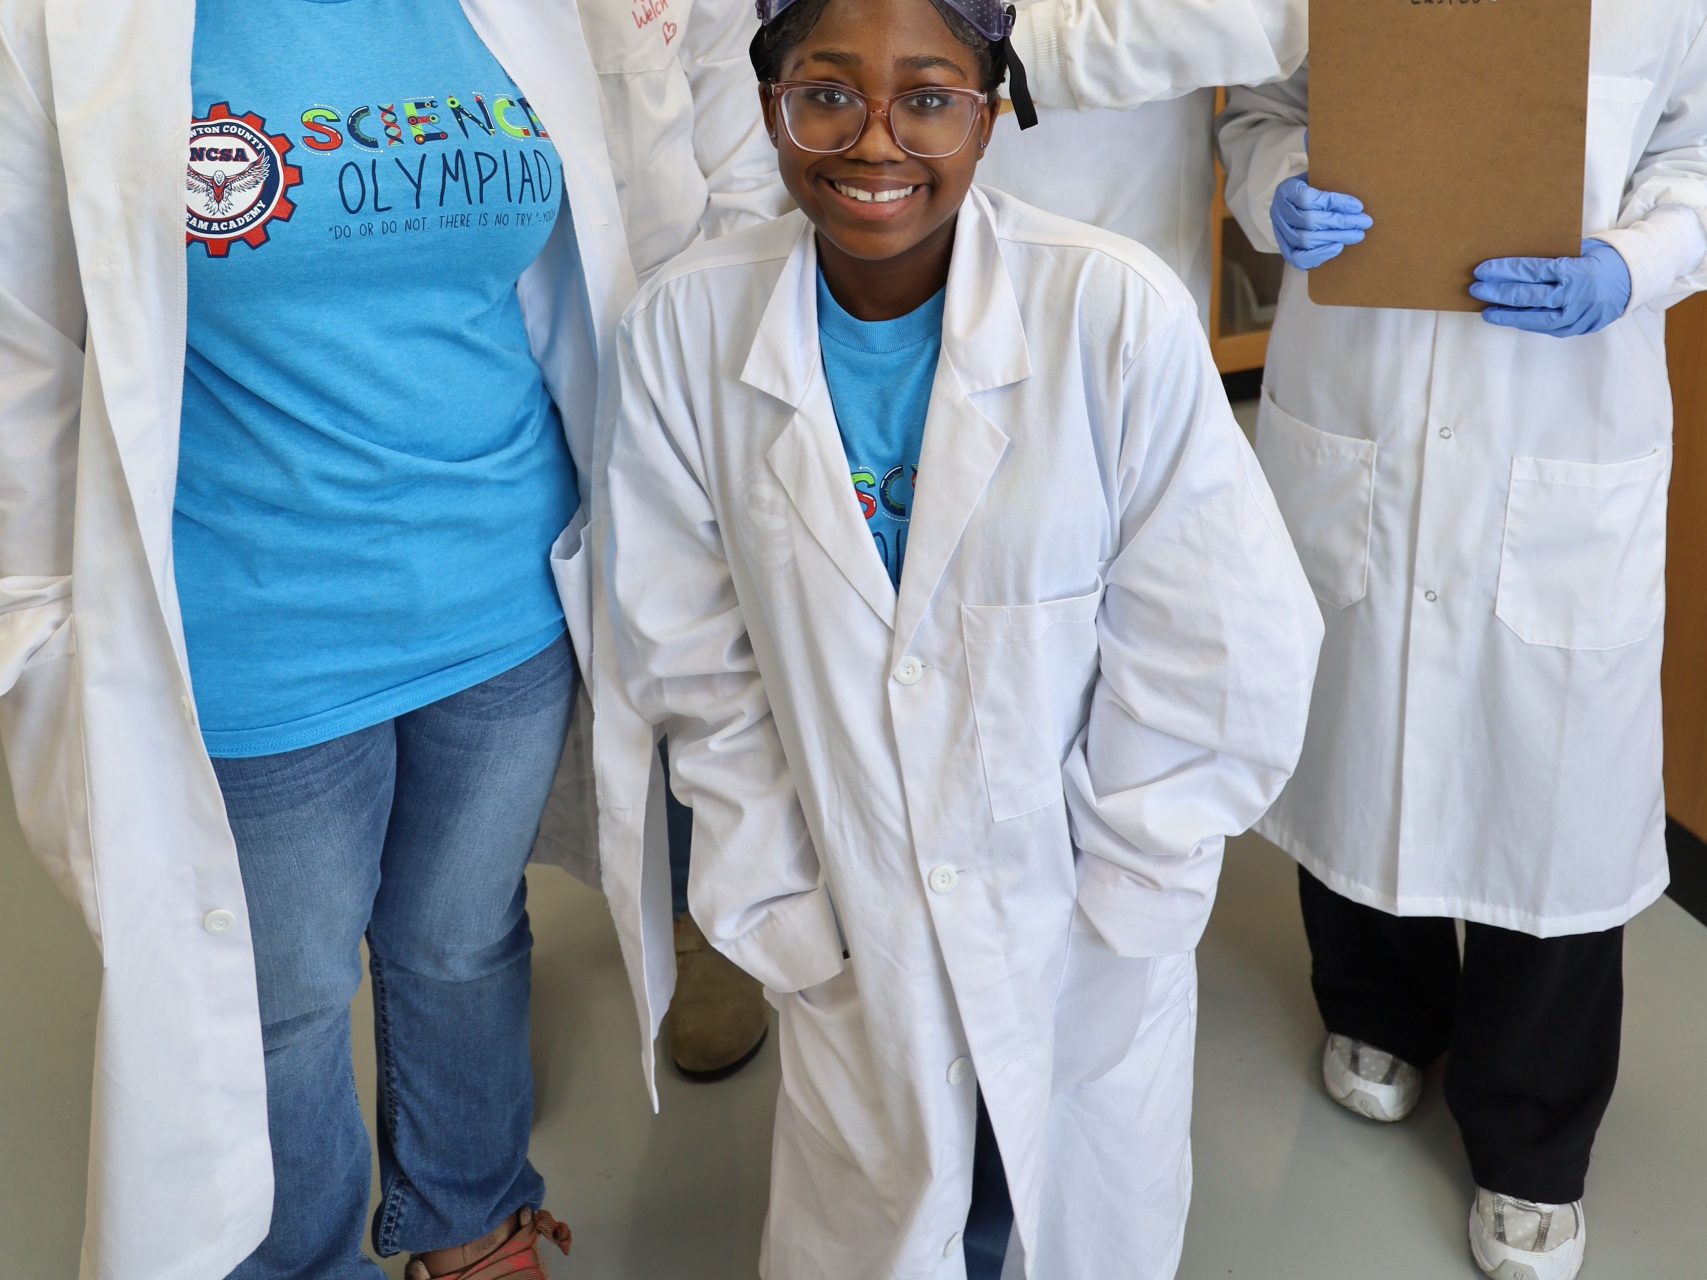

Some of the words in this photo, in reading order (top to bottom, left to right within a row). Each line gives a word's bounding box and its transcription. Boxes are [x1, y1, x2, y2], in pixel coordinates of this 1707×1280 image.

[222, 124, 265, 150] COUNTY
[190, 147, 250, 162] NCSA
[338, 148, 552, 215] OLYMPIAD
[211, 200, 266, 231] ACADEMY
[359, 222, 375, 237] OR
[381, 220, 398, 236] DO
[439, 213, 473, 229] THERE
[478, 212, 489, 227] IS
[494, 213, 510, 227] NO
